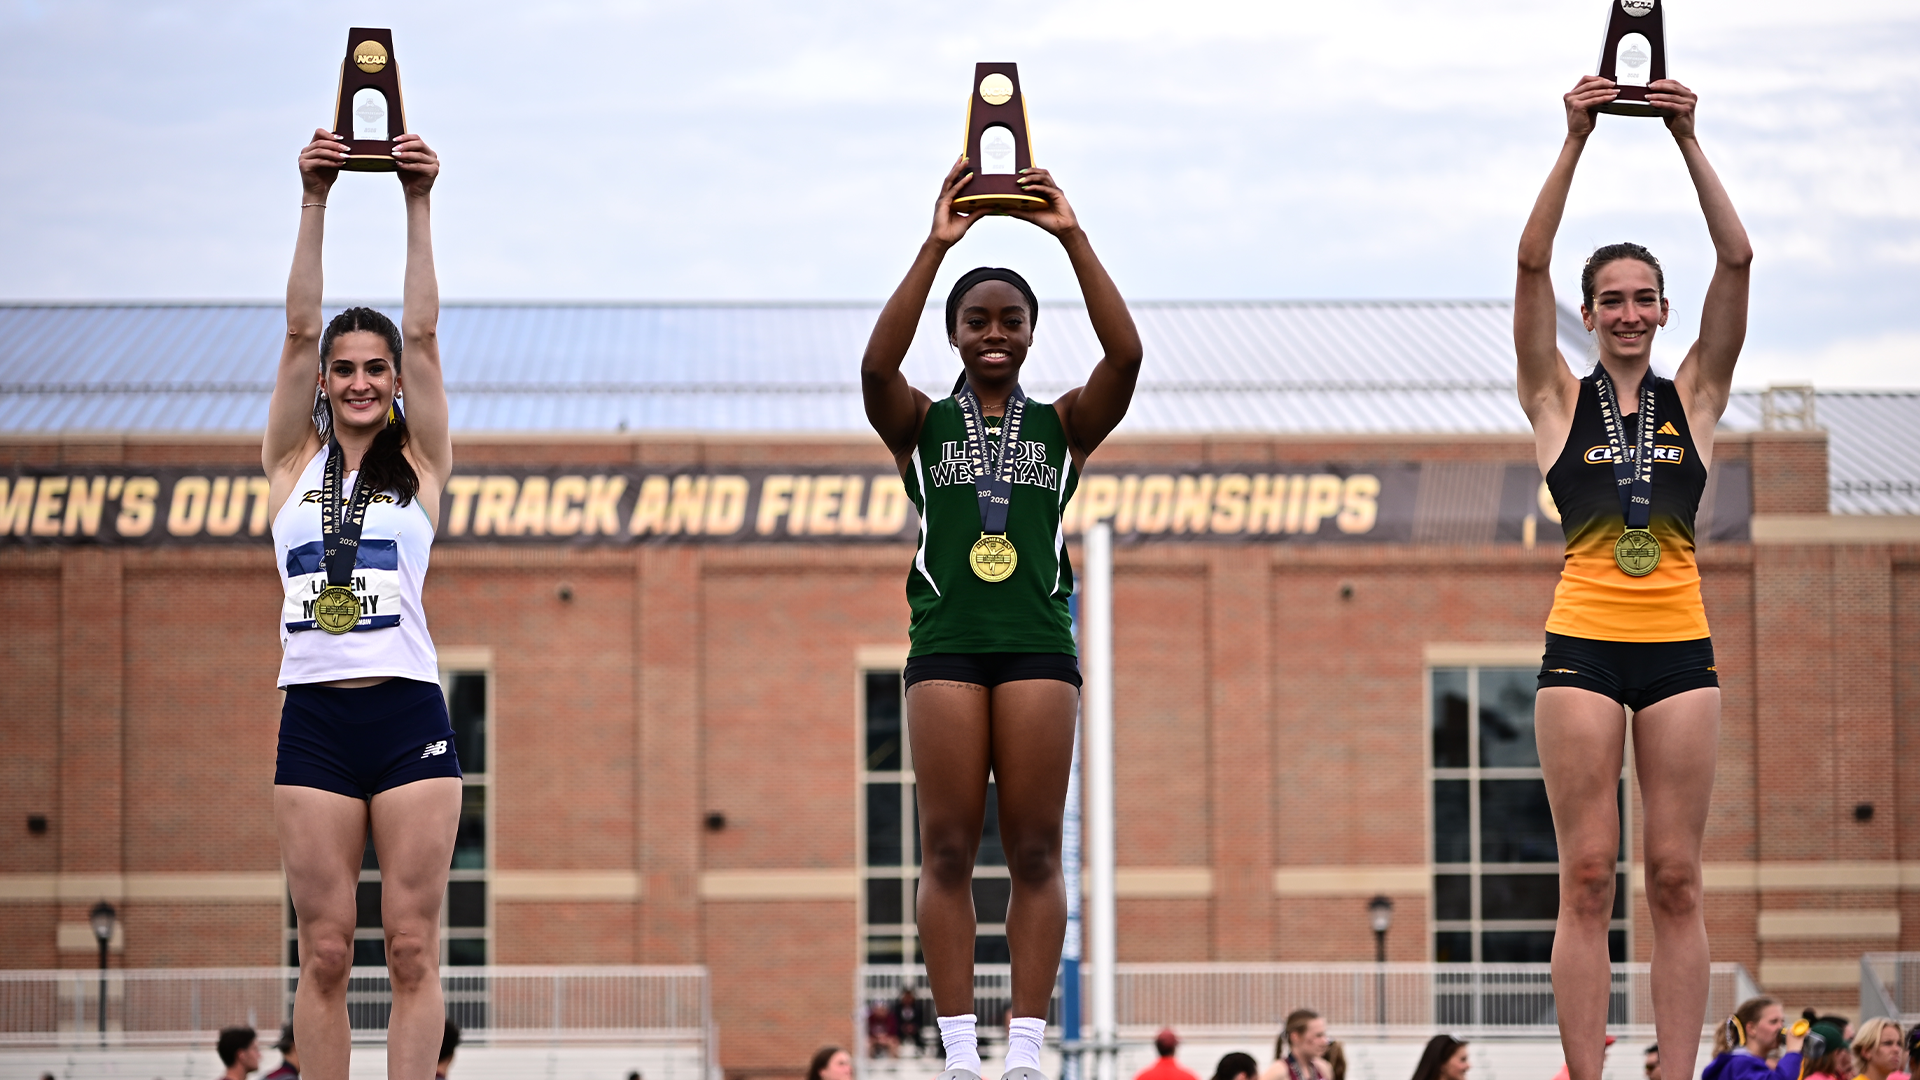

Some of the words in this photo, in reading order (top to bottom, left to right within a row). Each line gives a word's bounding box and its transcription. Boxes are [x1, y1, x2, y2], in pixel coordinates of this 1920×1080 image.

[357, 55, 386, 64] NCAA
[1618, 477, 1634, 486] 202
[990, 496, 1009, 505] 2026
[1631, 495, 1650, 505] 2026
[447, 475, 627, 536] TRACK
[630, 475, 750, 536] AND
[756, 475, 907, 536] FIELD
[339, 537, 358, 547] 2026
[312, 576, 366, 594] LAEN
[303, 595, 379, 619] MHY
